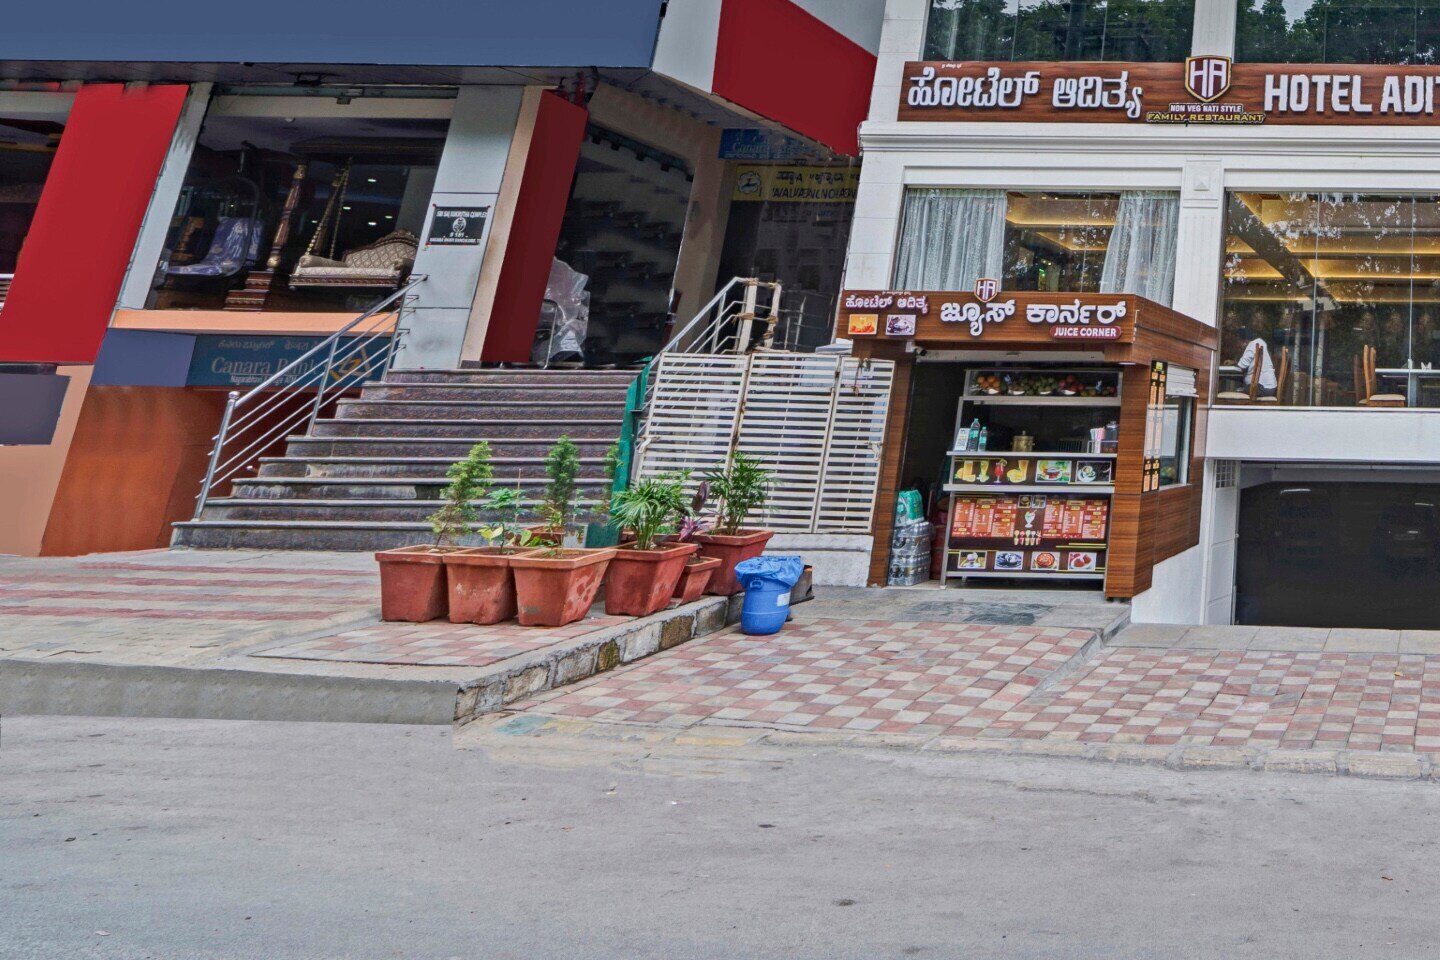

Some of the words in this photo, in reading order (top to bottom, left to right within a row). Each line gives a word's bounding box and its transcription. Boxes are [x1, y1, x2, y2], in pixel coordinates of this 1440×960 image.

[1189, 59, 1228, 98] HA
[908, 66, 1041, 108] ಹೋಟೆಲ್
[1052, 70, 1143, 118] ಆದಿತ್ಯ
[1264, 74, 1373, 112] HOTEL
[1148, 113, 1186, 121] FAMILY
[1189, 113, 1264, 122] RESTAURANT
[1170, 104, 1185, 113] NON
[1187, 104, 1201, 113] VEG
[1220, 104, 1242, 113] STYLE
[845, 294, 893, 309] ಹೋಟೆಲ್
[897, 295, 929, 315] ಆದಿತ್ಯ
[940, 299, 1016, 336] ಜ್ಯೂಸ್
[1054, 327, 1078, 337] JUICE
[1080, 327, 1117, 338] CORNER
[211, 357, 273, 374] Canara
